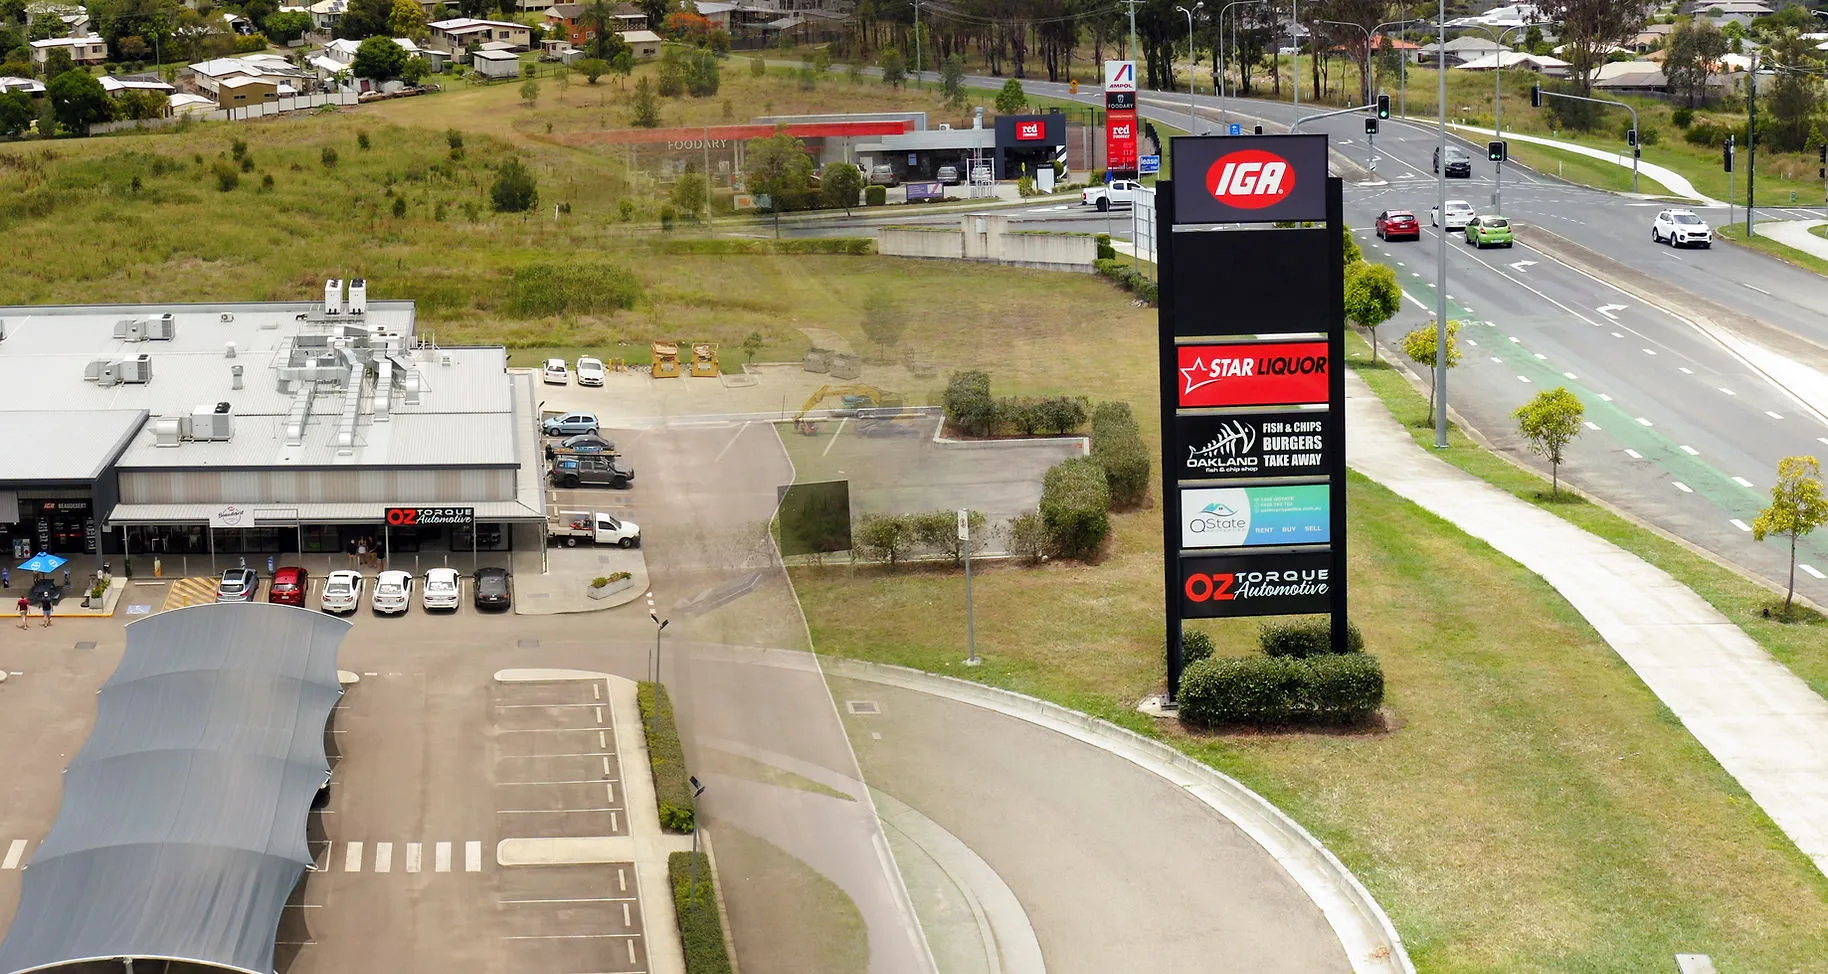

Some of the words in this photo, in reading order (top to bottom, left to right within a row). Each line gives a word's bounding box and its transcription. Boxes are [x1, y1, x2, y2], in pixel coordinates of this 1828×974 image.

[1022, 123, 1038, 134] red
[1112, 124, 1130, 135] red
[667, 139, 728, 150] FOODARY
[1215, 161, 1287, 196] IGA
[1209, 357, 1255, 378] STAR
[1257, 356, 1328, 376] LIQUOR
[1262, 422, 1284, 434] FISH
[1284, 423, 1293, 433] &
[1293, 421, 1322, 433] CHIPS
[1263, 435, 1323, 451] BURGERS
[1186, 456, 1259, 468] OAKLAND
[1263, 454, 1290, 467] TAKE
[1291, 453, 1322, 466] AWAY
[387, 508, 417, 526] OZ
[416, 508, 473, 516] TORQUE
[415, 513, 472, 525] Automotive
[1189, 518, 1246, 533] QState
[1184, 572, 1235, 603] OZ
[1234, 569, 1329, 584] TORQUE
[1233, 580, 1330, 601] Automotive
